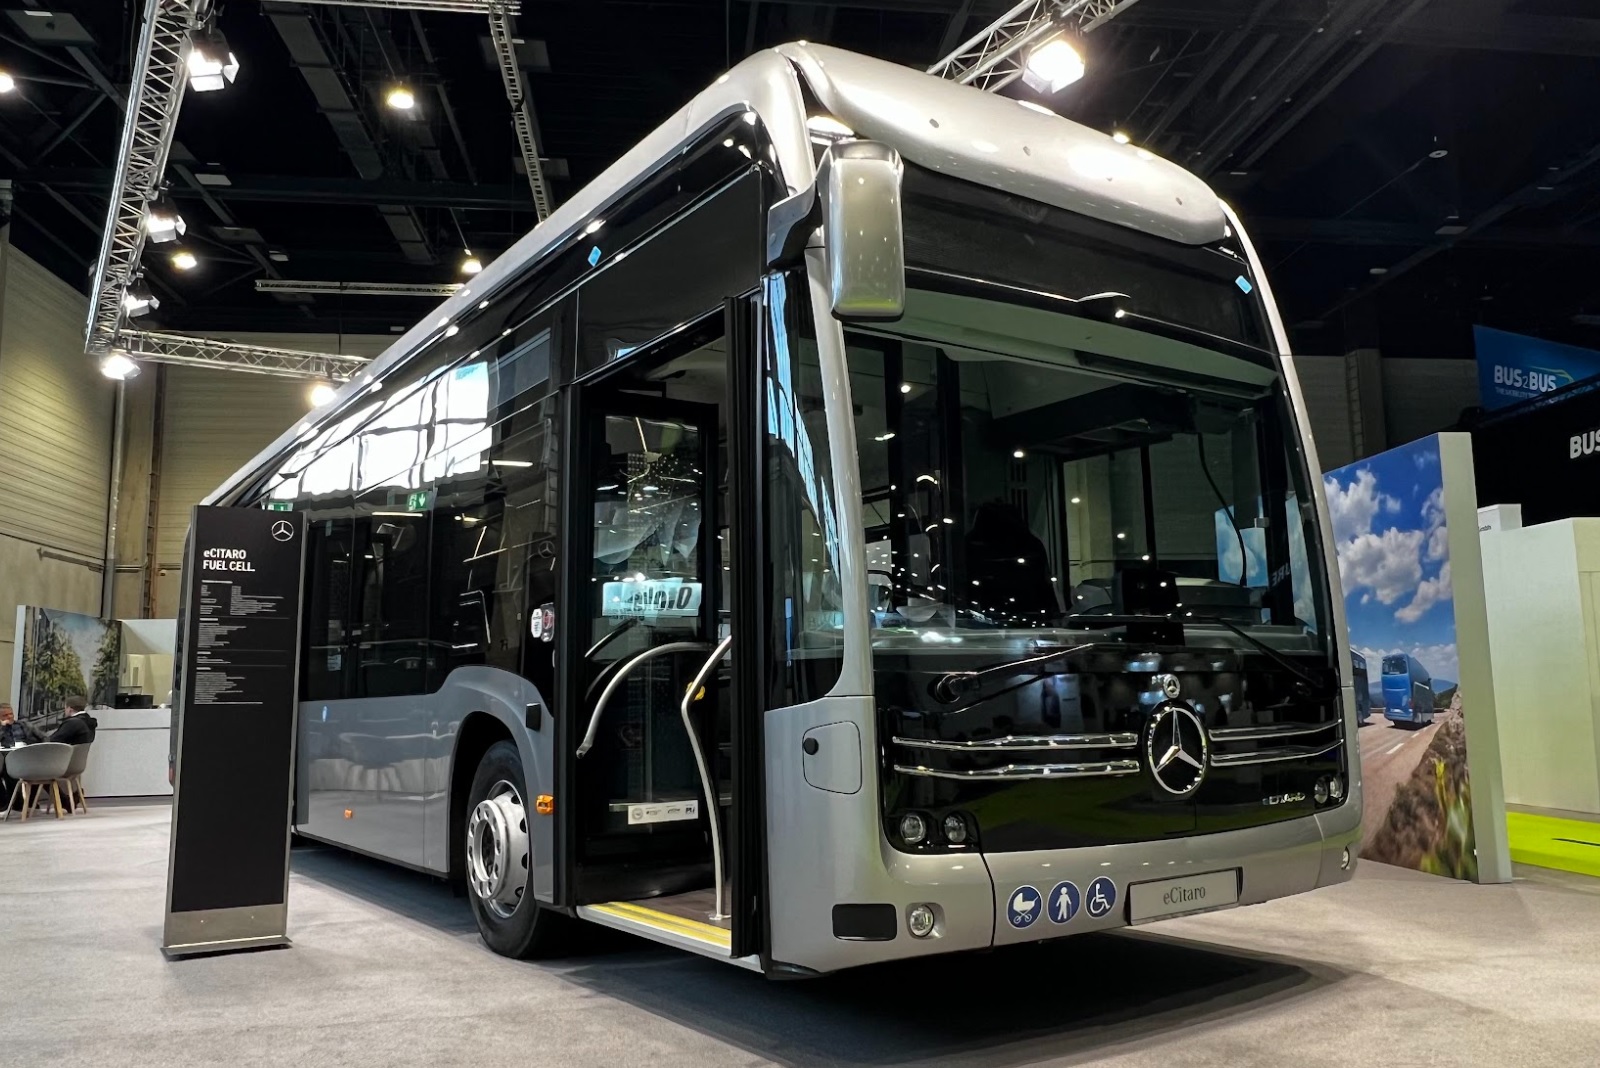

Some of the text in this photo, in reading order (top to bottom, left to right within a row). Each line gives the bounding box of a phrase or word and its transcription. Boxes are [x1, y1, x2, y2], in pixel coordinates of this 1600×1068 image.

[1493, 364, 1558, 393] BUS2BUS
[203, 547, 247, 560] eCITARO
[202, 559, 228, 571] FUEL
[1163, 886, 1206, 905] eCitaro
